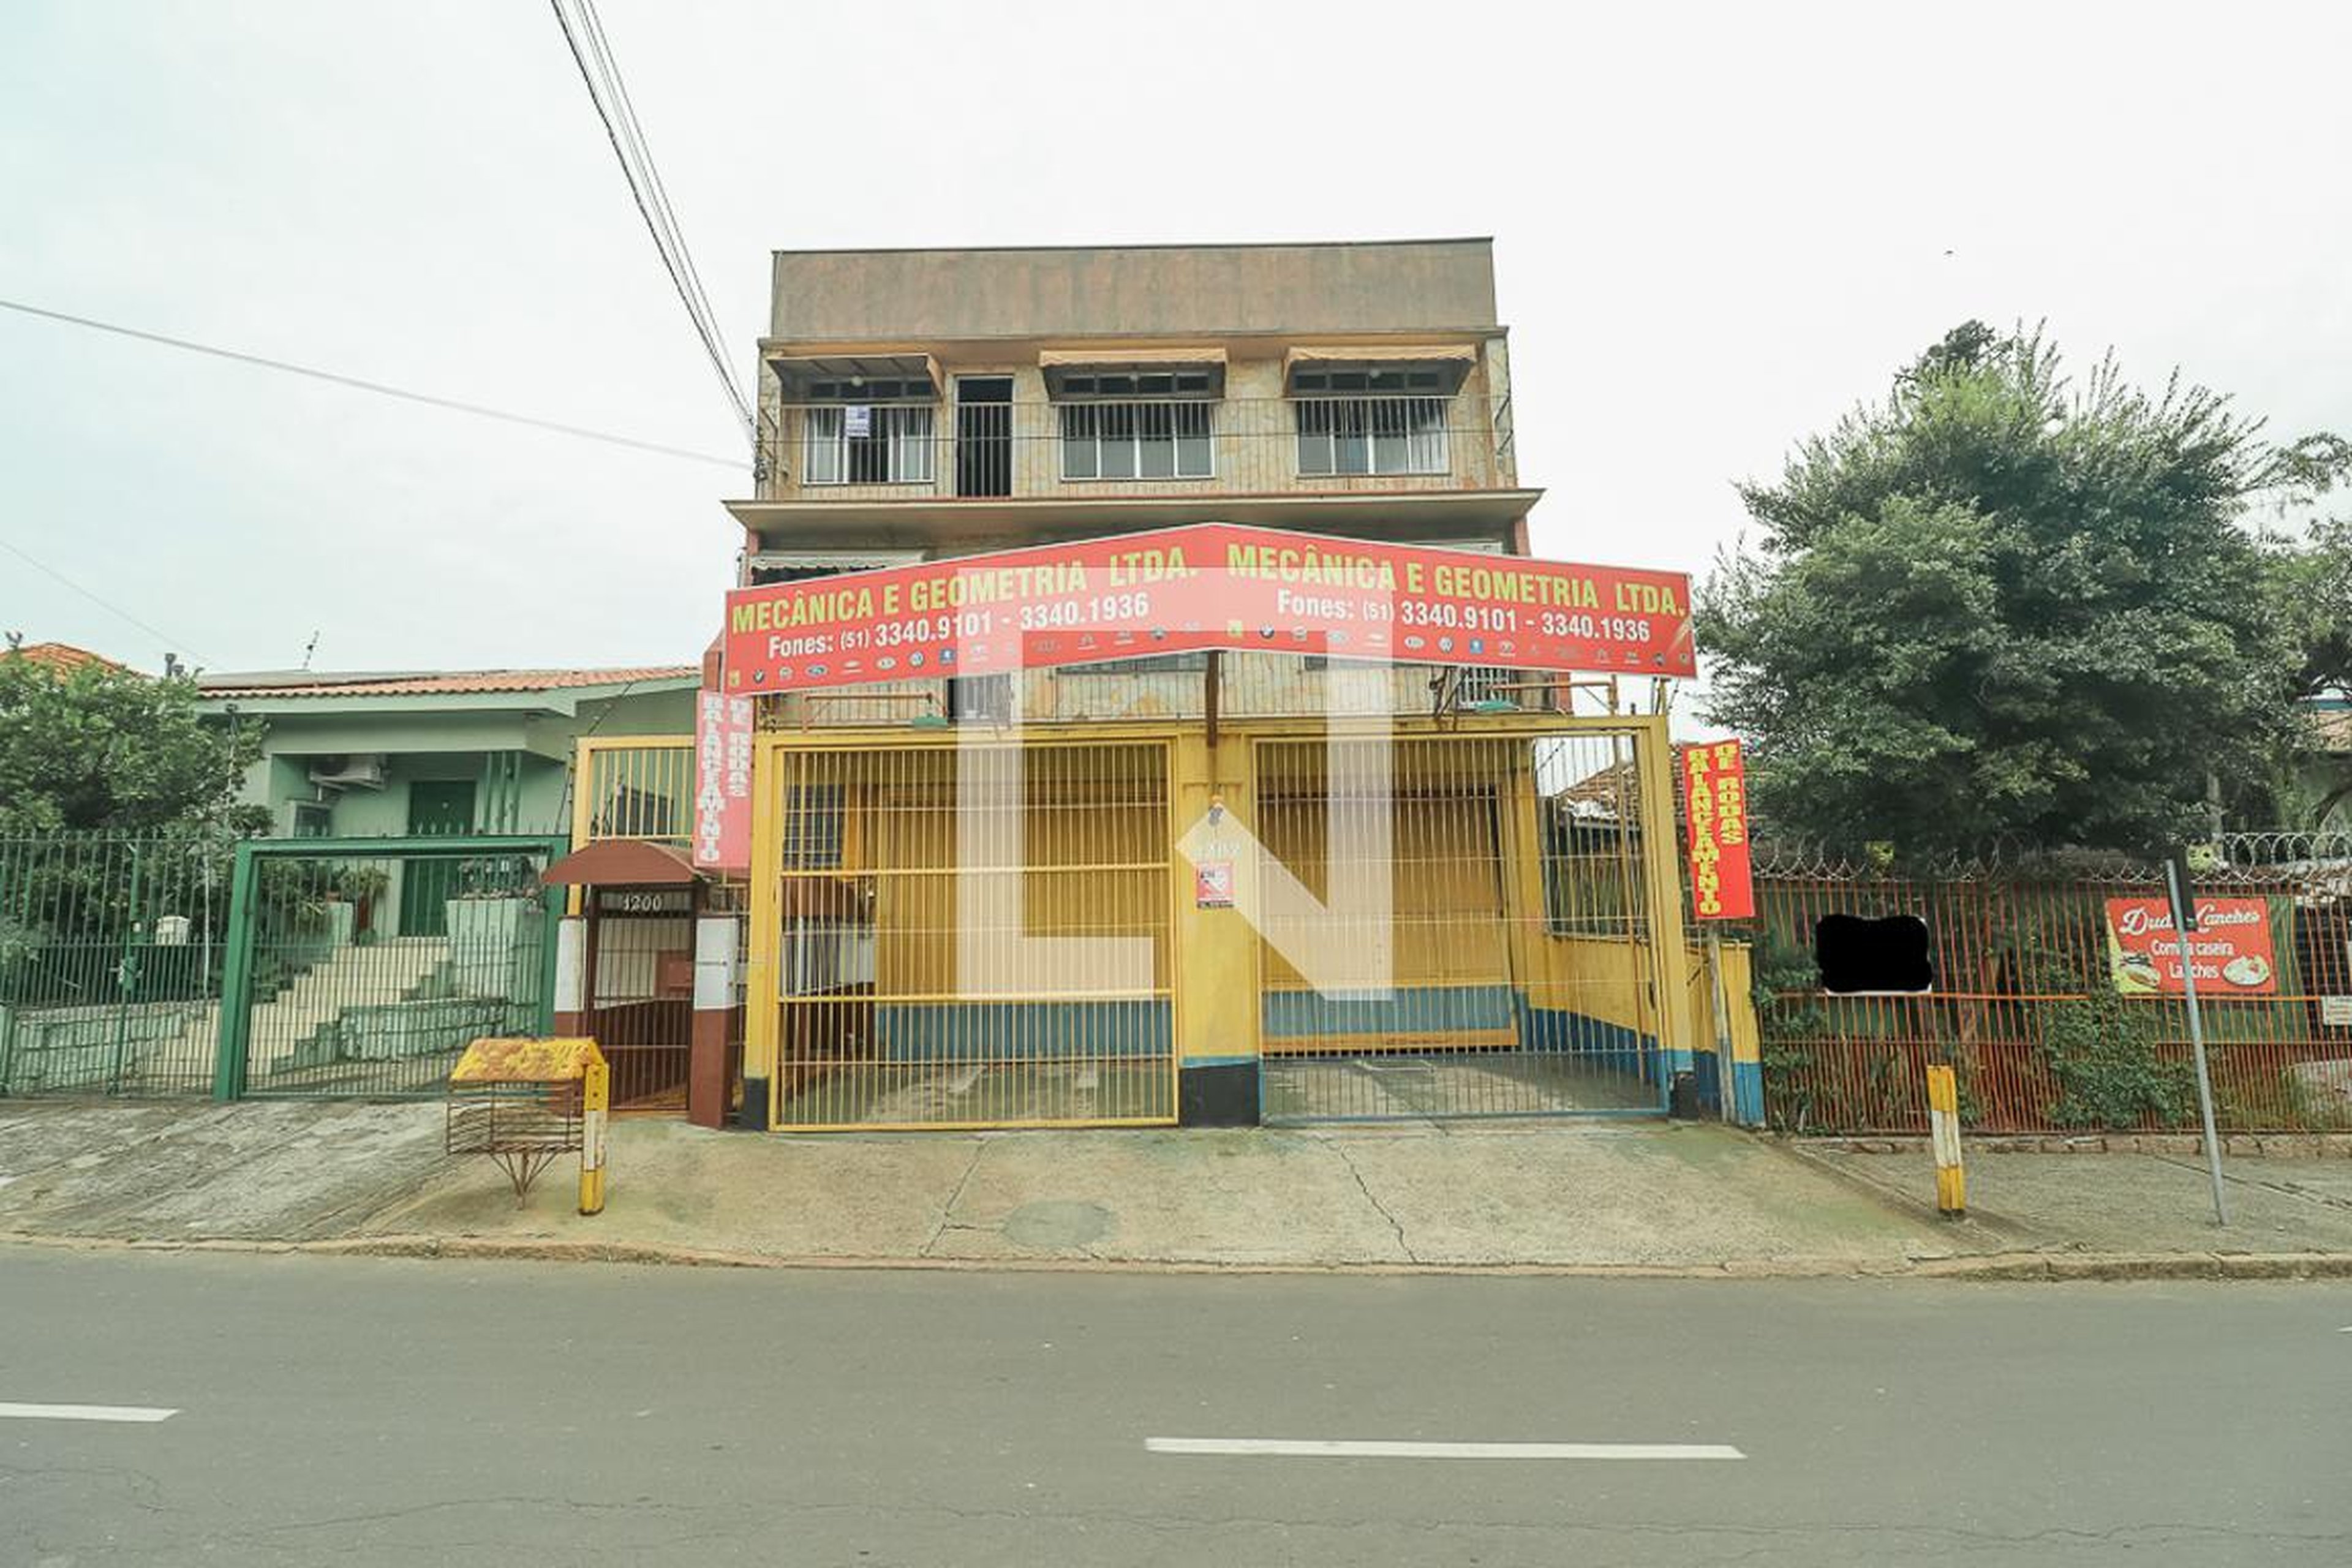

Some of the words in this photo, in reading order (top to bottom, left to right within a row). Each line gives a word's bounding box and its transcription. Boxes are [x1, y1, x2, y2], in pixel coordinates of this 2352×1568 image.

[733, 587, 873, 633] MECÂNICA
[882, 585, 900, 613] E
[910, 560, 1087, 611] GEOMETRIA
[1109, 546, 1199, 587] LTDA.
[1227, 544, 1396, 590] MECÂNICA
[1407, 562, 1425, 593] E
[1434, 565, 1599, 609] GEOMETRIA
[769, 633, 834, 660] Fones:
[840, 629, 870, 652] (51)
[875, 611, 992, 647] 3340.9101
[1020, 590, 1150, 631] 3340.1936
[1277, 588, 1354, 620] Fones:
[1401, 600, 1517, 633] 3340.9101
[1541, 612, 1651, 643] 3340.1936
[1715, 744, 1737, 770] DE
[1717, 778, 1743, 844] RODAS
[624, 893, 662, 911] 1200
[2168, 960, 2220, 979] Laches
[2196, 938, 2235, 956] caseira
